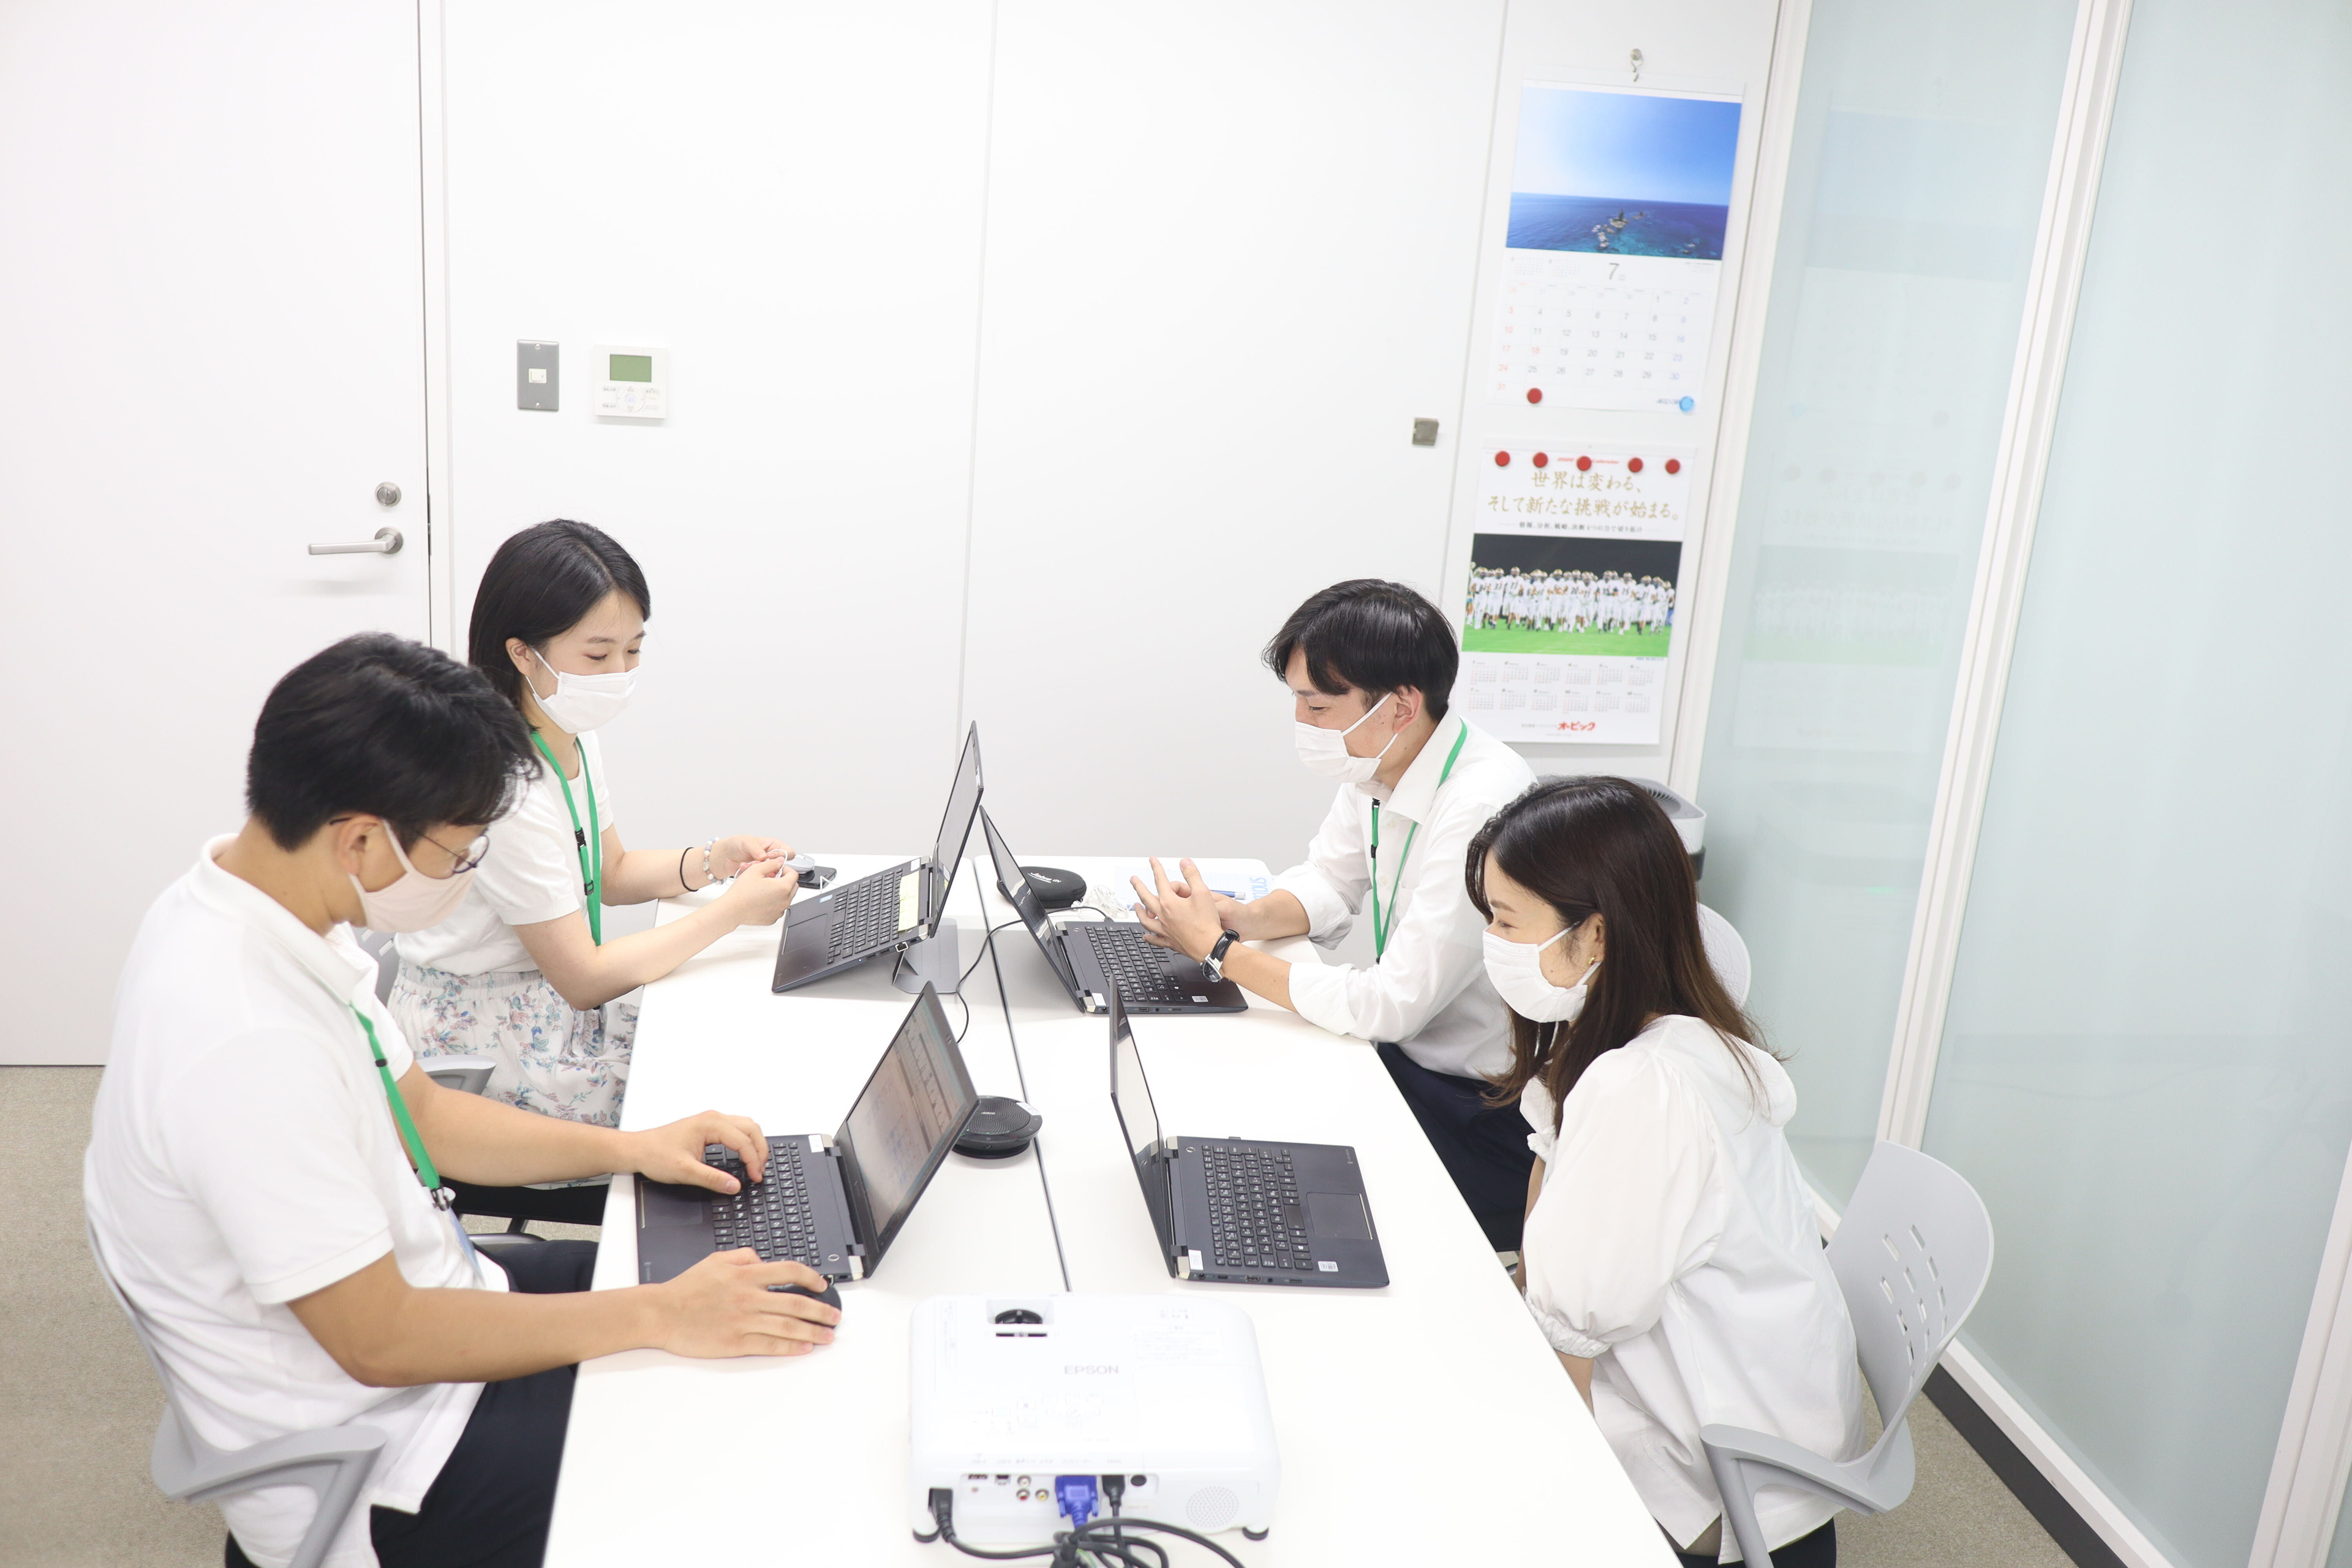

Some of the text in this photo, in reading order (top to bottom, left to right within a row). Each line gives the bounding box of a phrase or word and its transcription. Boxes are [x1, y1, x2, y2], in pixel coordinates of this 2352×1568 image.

[1608, 263, 1620, 281] 7
[1531, 470, 1642, 493] 世界は変わる、
[1488, 496, 1679, 521] そして新たな挑戦が始まる。
[1557, 721, 1596, 731] オービック
[1063, 1365, 1120, 1375] EPSON
